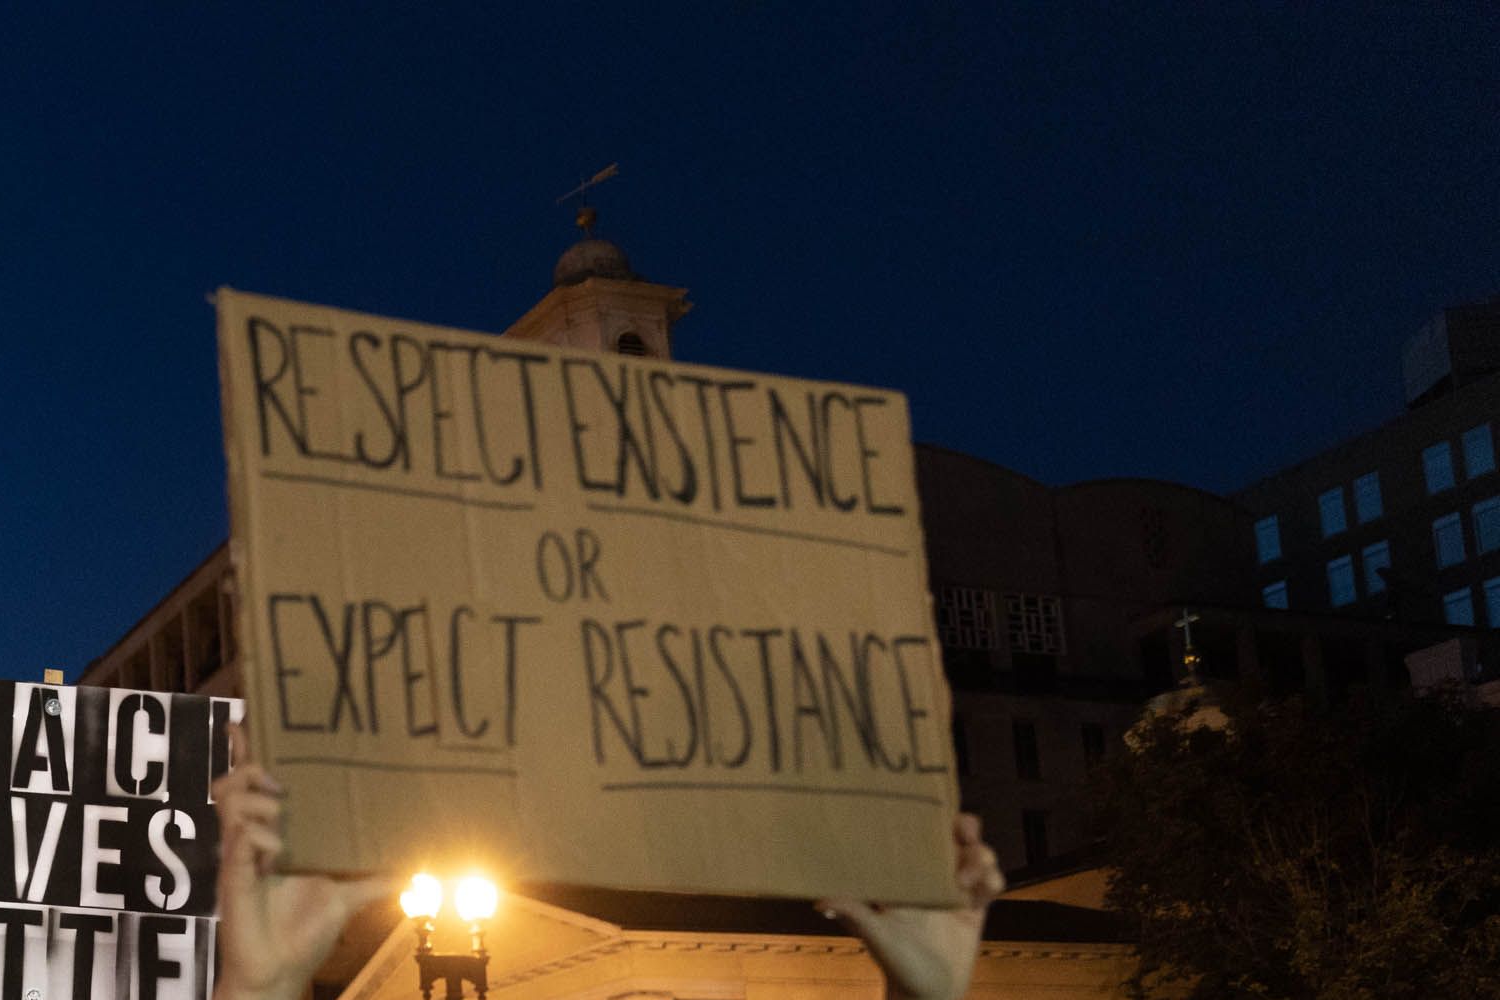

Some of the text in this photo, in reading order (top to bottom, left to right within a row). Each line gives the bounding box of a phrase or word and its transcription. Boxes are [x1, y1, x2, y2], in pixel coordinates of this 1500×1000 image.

[247, 316, 905, 515] RESPECT EXISTENCE
[536, 527, 608, 601] OR
[268, 594, 947, 774] EXPECT RESISTANCE
